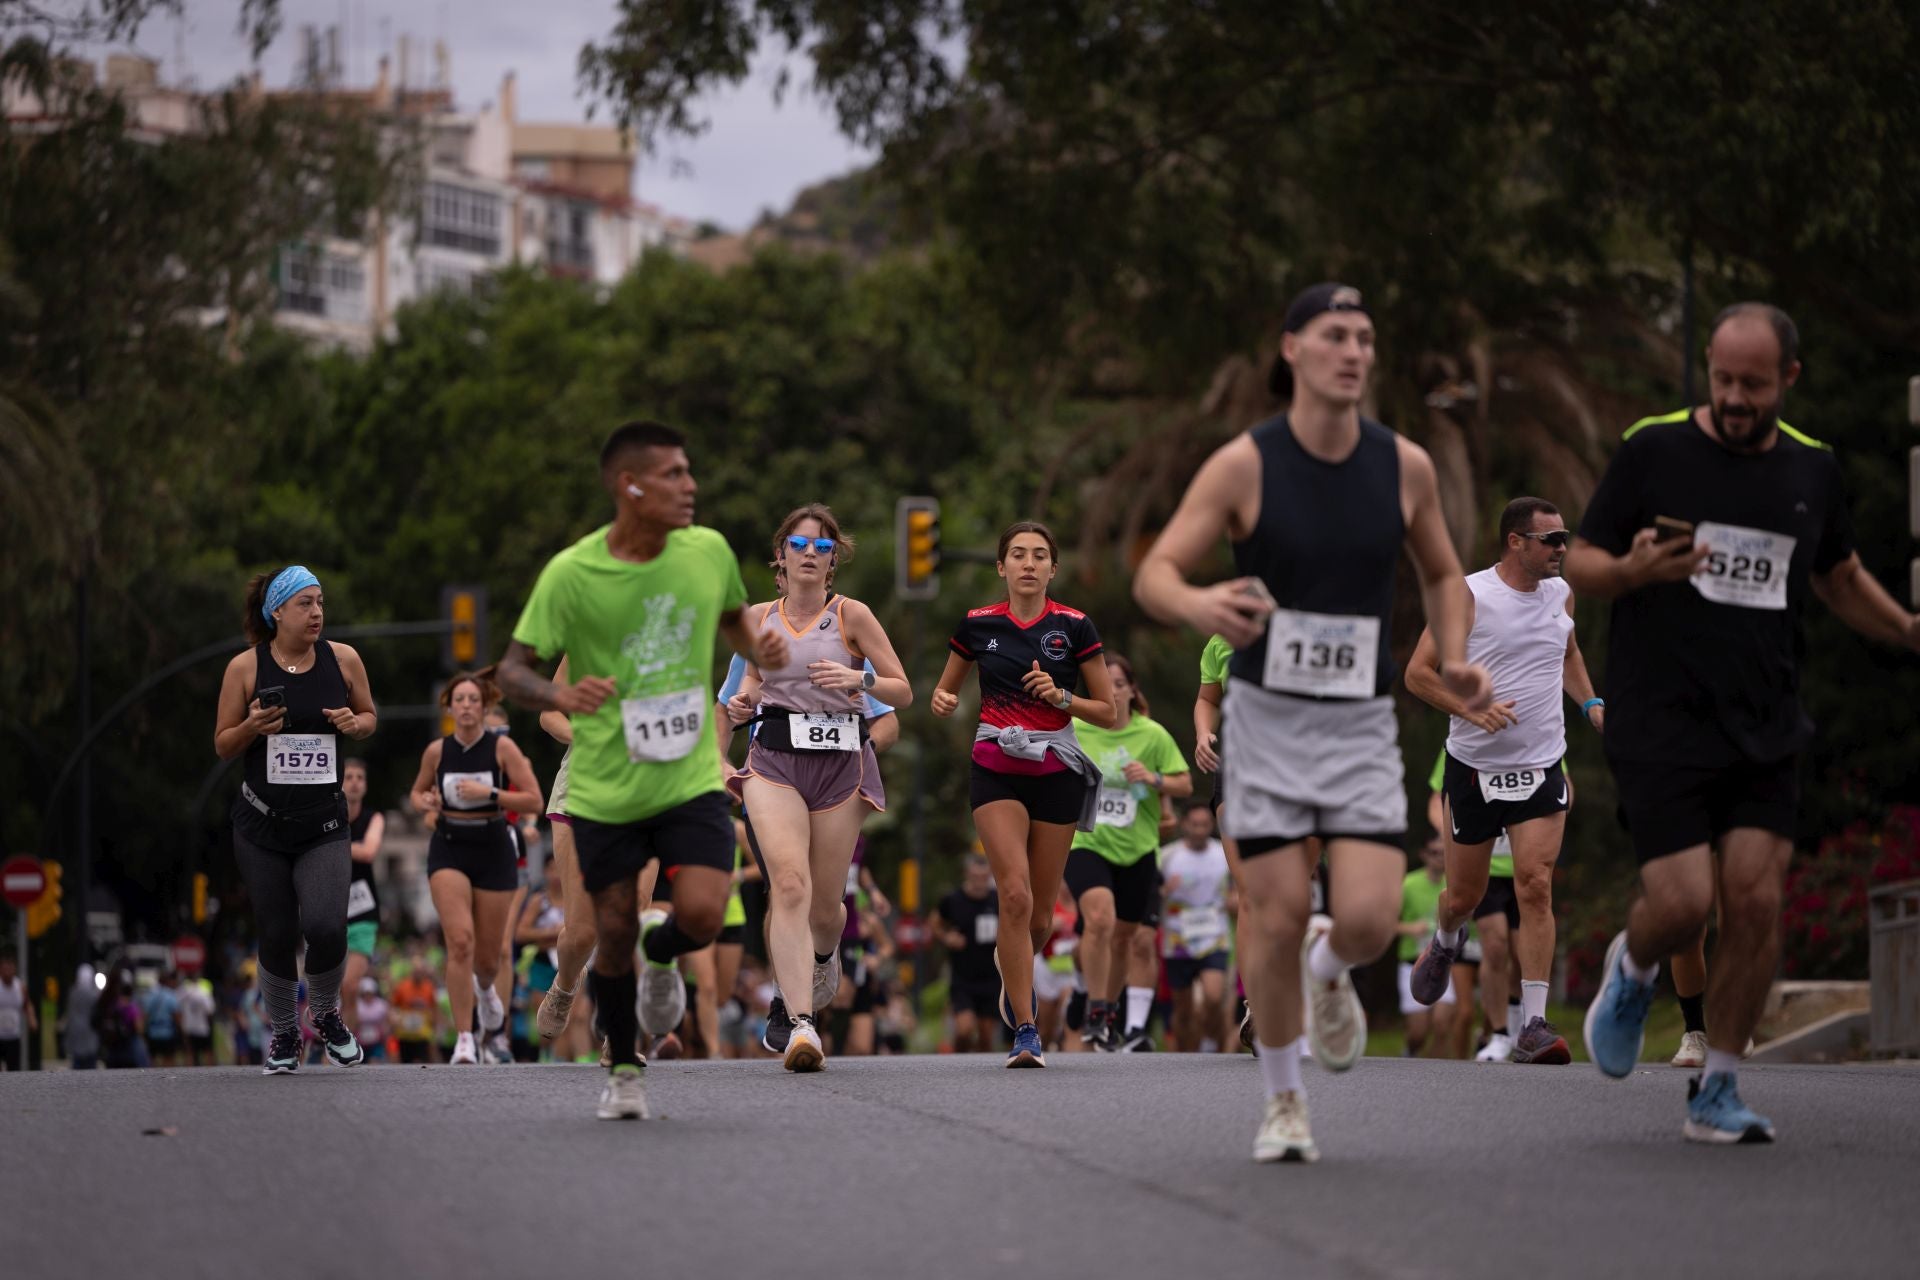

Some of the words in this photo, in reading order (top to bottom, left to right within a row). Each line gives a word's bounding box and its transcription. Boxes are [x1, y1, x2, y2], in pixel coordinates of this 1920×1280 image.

[1707, 551, 1772, 583] 529
[1286, 640, 1357, 671] 136
[636, 712, 699, 740] 1198
[809, 726, 840, 744] 84
[274, 752, 328, 768] 1579
[1489, 771, 1535, 789] 489
